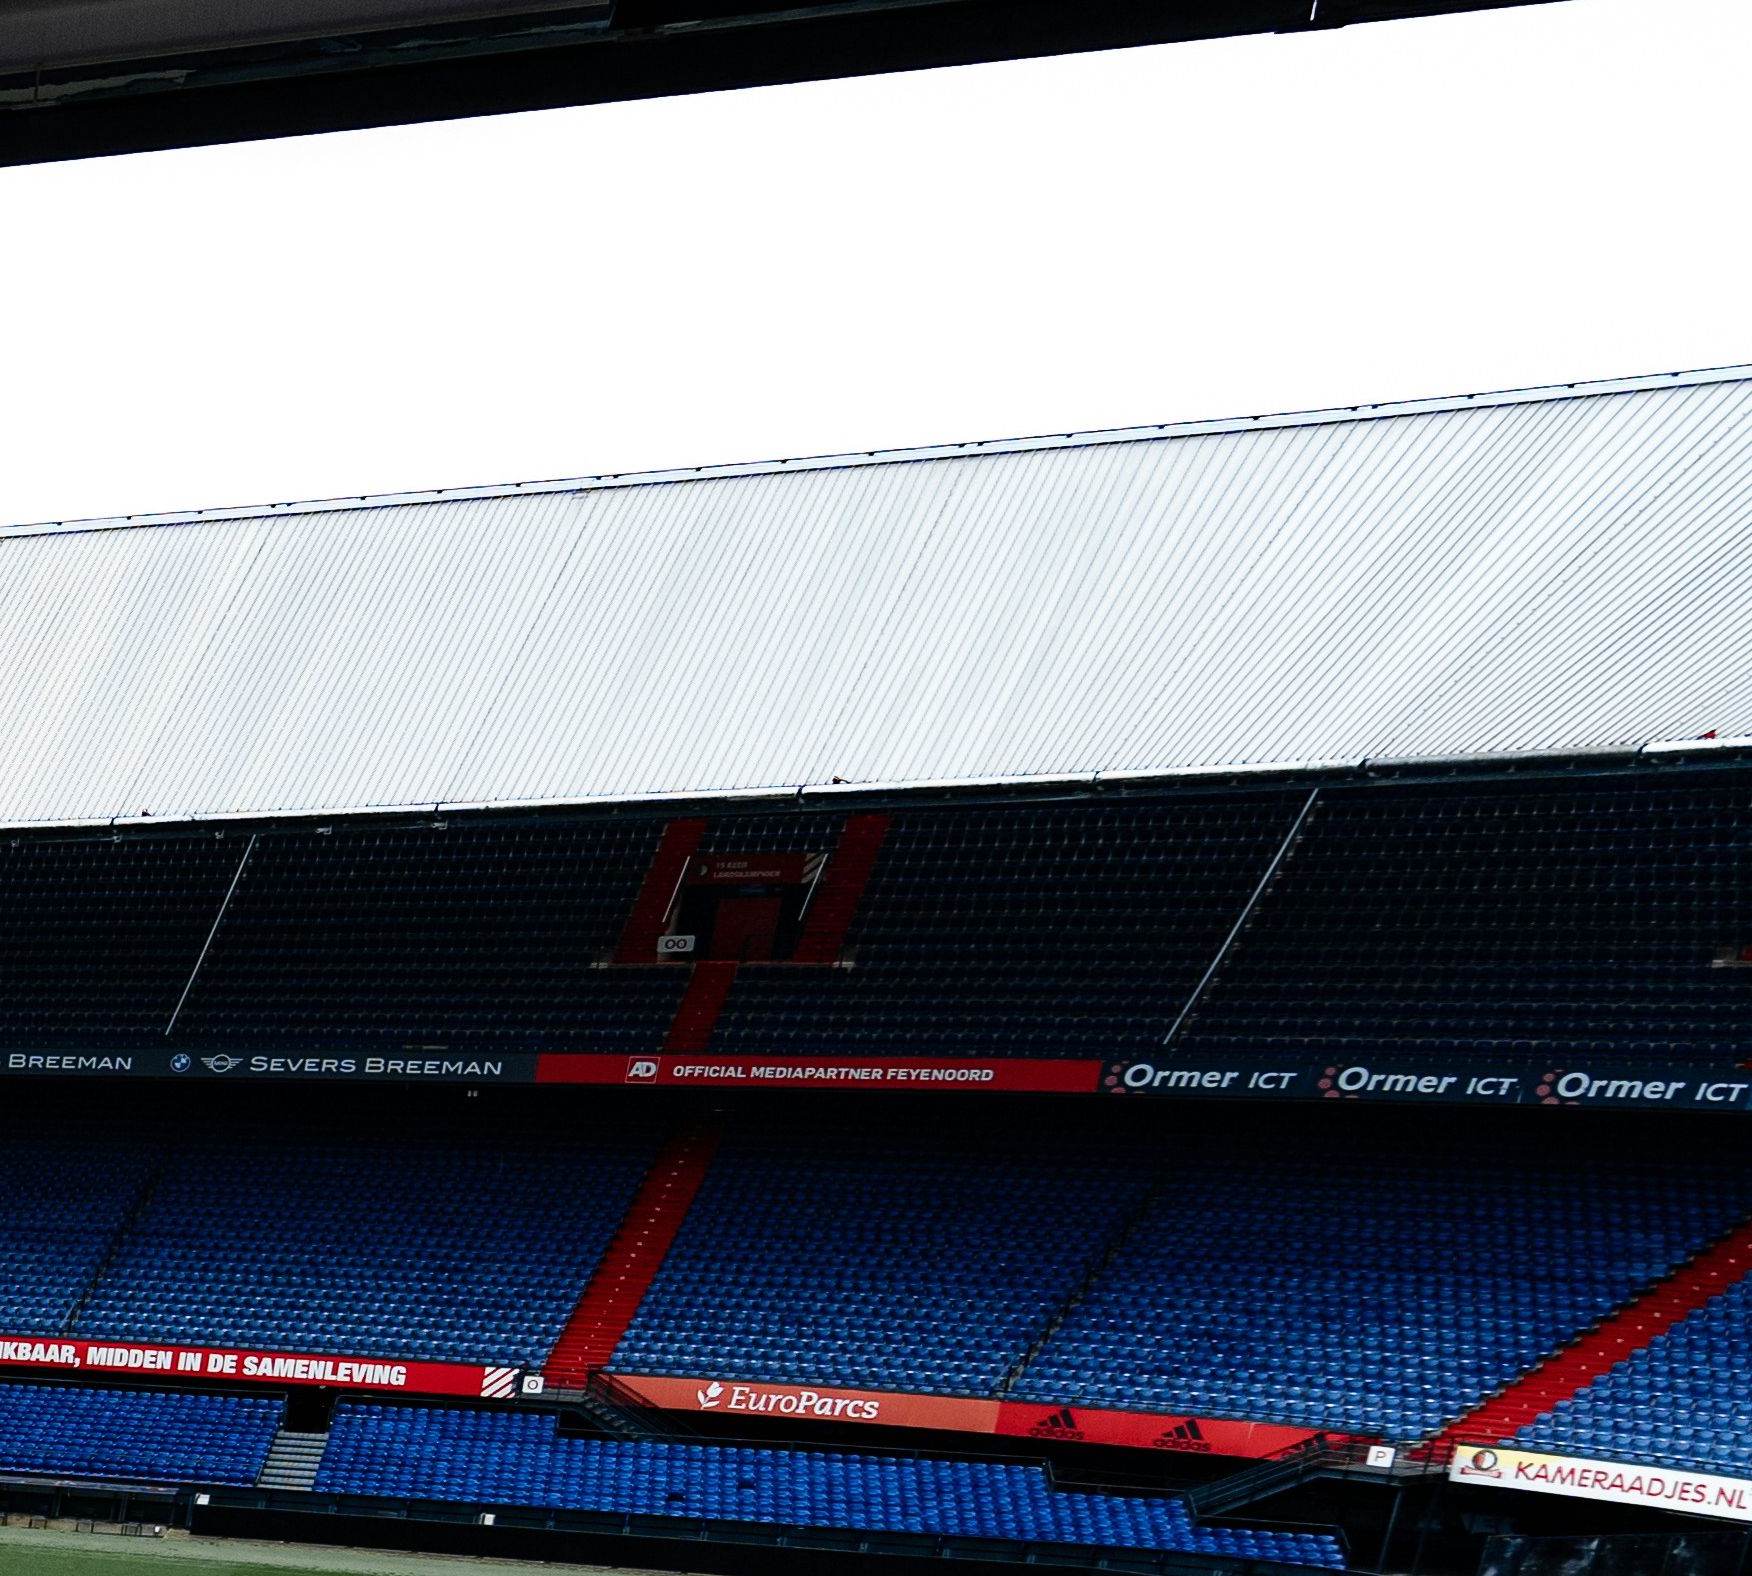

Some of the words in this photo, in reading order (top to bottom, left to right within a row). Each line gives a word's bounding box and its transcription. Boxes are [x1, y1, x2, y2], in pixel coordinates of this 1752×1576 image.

[8, 1053, 133, 1070] BREEMAN
[249, 1056, 356, 1073] SEVERS
[364, 1057, 502, 1076] BREEMAN
[628, 1061, 657, 1077] AD
[672, 1065, 746, 1078] OFFICIAL
[749, 1066, 882, 1081] MEDIAPARTNER
[886, 1068, 994, 1082] FEYENOORD
[1124, 1063, 1239, 1088] Ormer
[1248, 1072, 1298, 1089] ICT
[1337, 1067, 1458, 1094] Ormer
[1465, 1077, 1518, 1095] ICT
[1557, 1072, 1687, 1100] Ormer
[1694, 1083, 1750, 1102] ICT
[86, 1346, 172, 1369] MIDDEN
[178, 1350, 201, 1371] IN
[207, 1353, 238, 1374] DE
[242, 1355, 407, 1386] SAMENLEVING
[727, 1386, 879, 1419] EuroParcs
[1028, 1425, 1084, 1441] adidas
[1153, 1435, 1211, 1453] adidas
[1375, 1451, 1387, 1463] P
[1514, 1460, 1748, 1510] KAMERAADJES.NL
